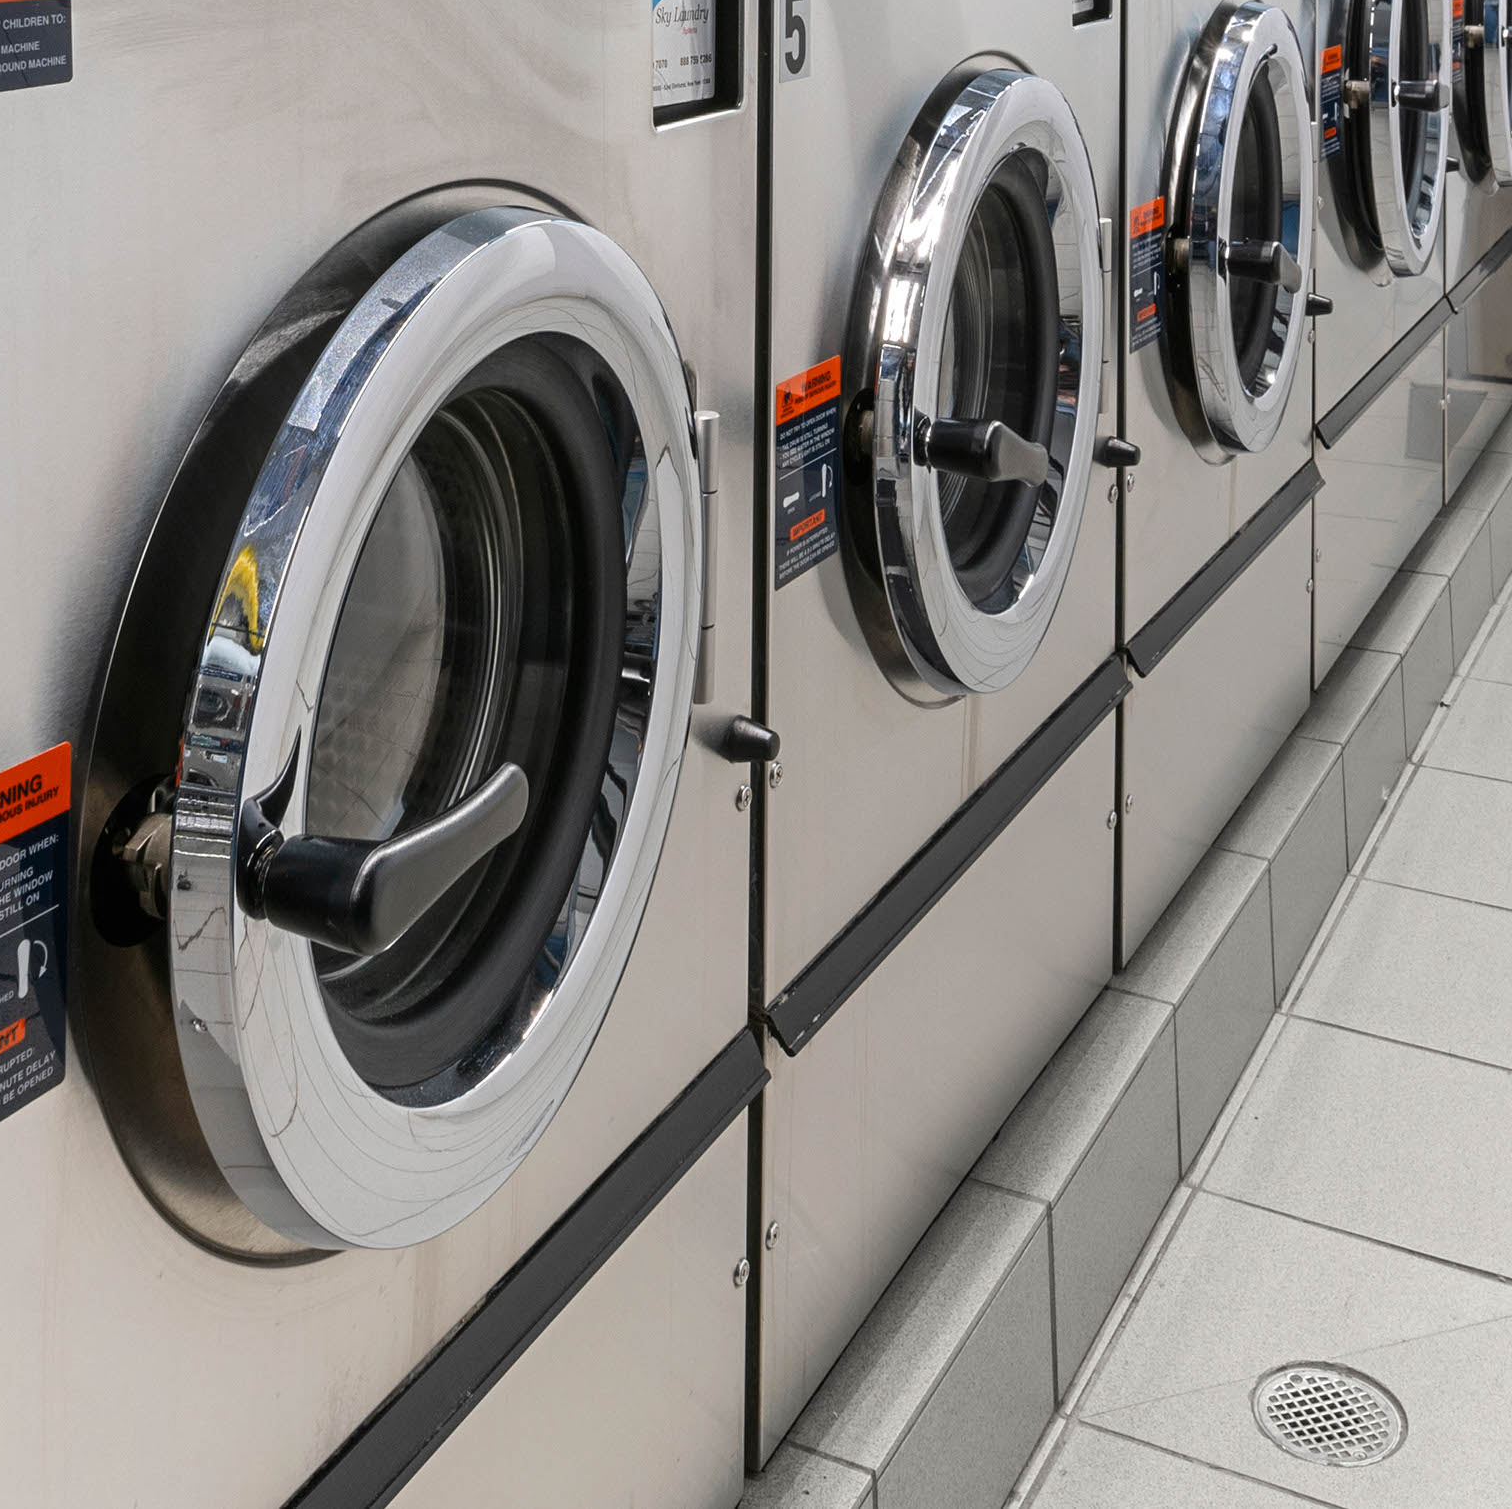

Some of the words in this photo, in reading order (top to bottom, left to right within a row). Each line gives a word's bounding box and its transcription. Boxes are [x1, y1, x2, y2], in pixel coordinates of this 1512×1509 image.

[2, 16, 50, 30] CHILDREN
[51, 13, 67, 25] TO:
[655, 5, 672, 27] Sky
[673, 3, 709, 25] Laundry
[1, 40, 41, 55] MACHINE
[28, 55, 67, 70] MACHINE
[25, 786, 59, 811] INJURY
[0, 849, 27, 871] DOOR
[28, 833, 59, 855] WHEN:
[13, 870, 53, 898] WINDOW
[26, 891, 40, 906] ON
[26, 1049, 56, 1076] DELAY
[2, 1089, 15, 1105] BE
[17, 1066, 54, 1095] OPENED
